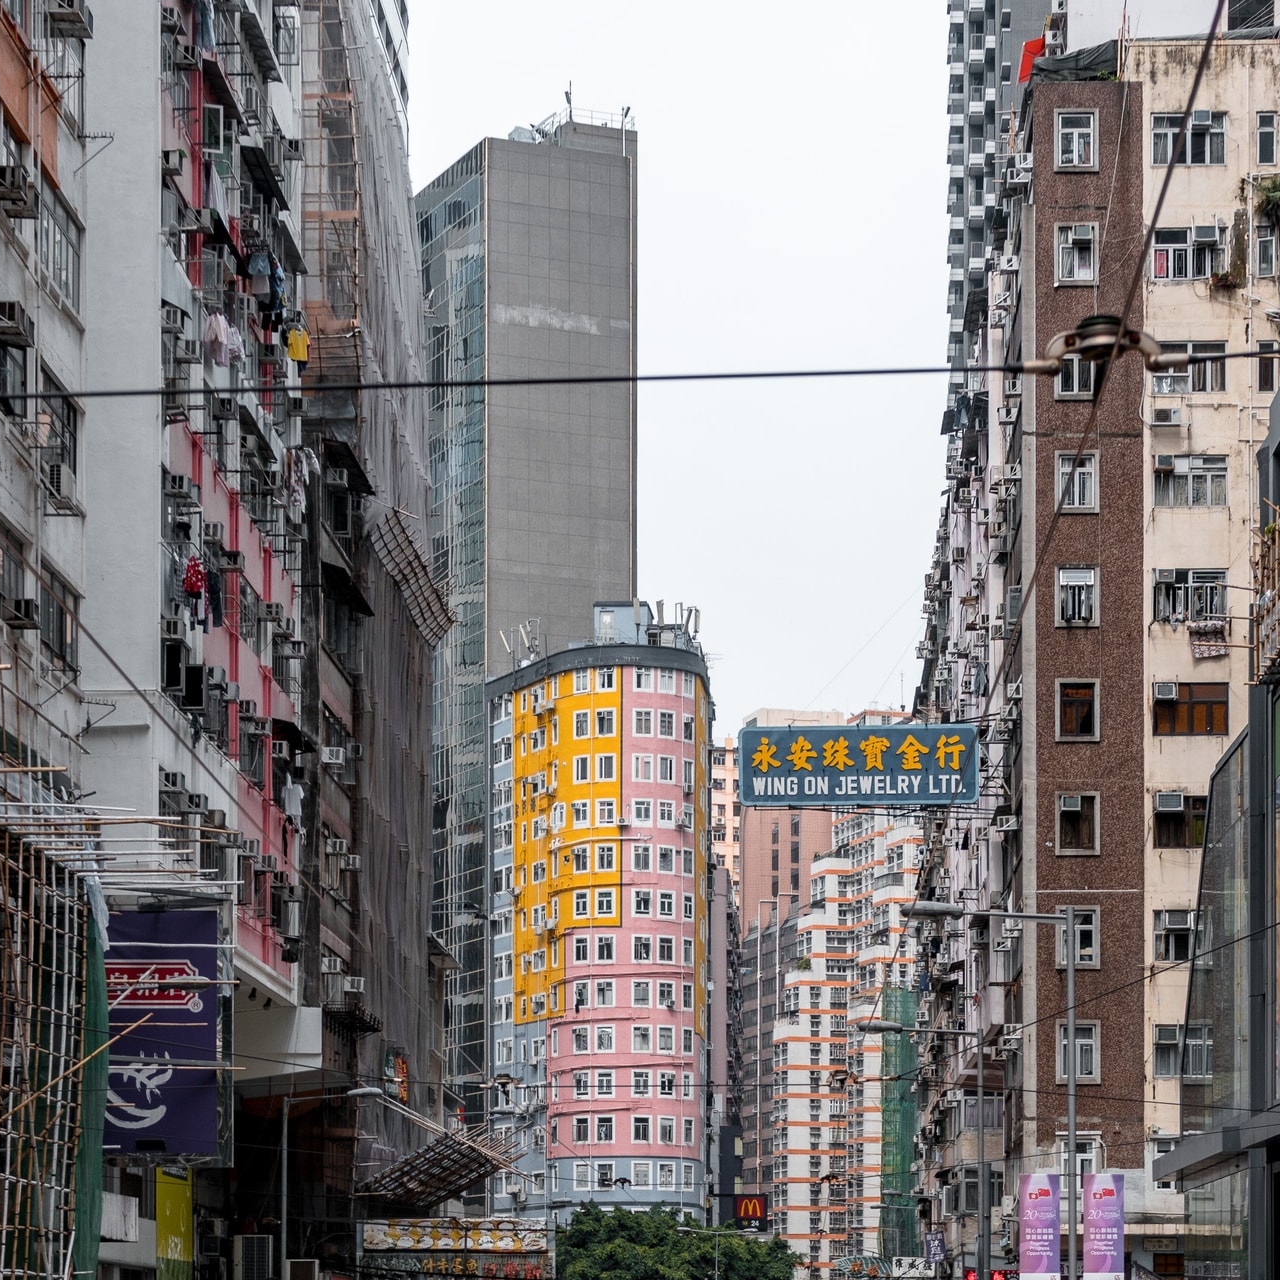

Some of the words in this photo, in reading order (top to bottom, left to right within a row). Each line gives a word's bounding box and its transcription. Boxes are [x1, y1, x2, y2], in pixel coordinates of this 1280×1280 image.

[751, 734, 966, 773] 永安珠寶金行
[753, 776, 798, 796] WING
[804, 776, 829, 795] ON
[835, 775, 921, 796] JEWELRY
